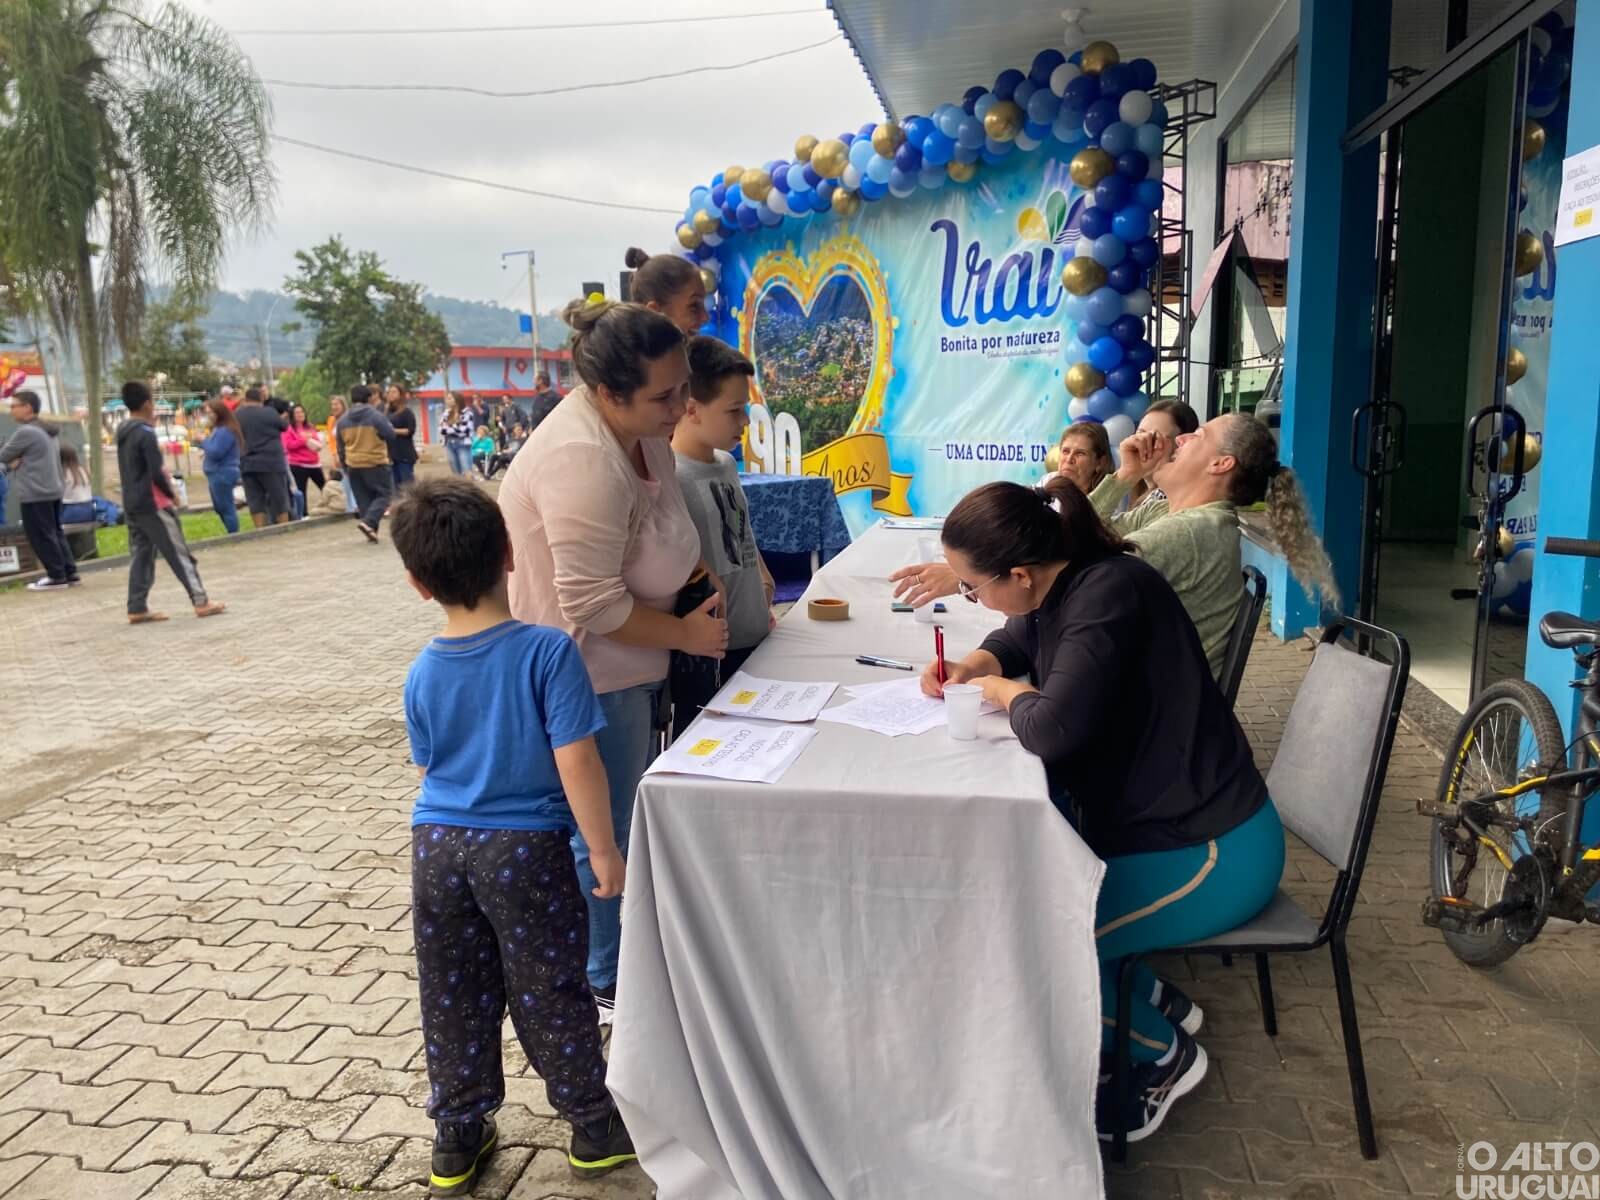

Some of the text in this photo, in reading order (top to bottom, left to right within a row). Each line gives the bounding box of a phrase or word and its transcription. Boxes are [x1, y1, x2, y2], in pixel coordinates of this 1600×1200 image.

[941, 335, 977, 352] Bonita
[981, 336, 1002, 354] por
[1006, 330, 1061, 347] natureza
[749, 403, 801, 476] 90
[946, 444, 973, 460] UMA
[976, 444, 1026, 463] CIDADE,
[805, 454, 875, 488] Anos
